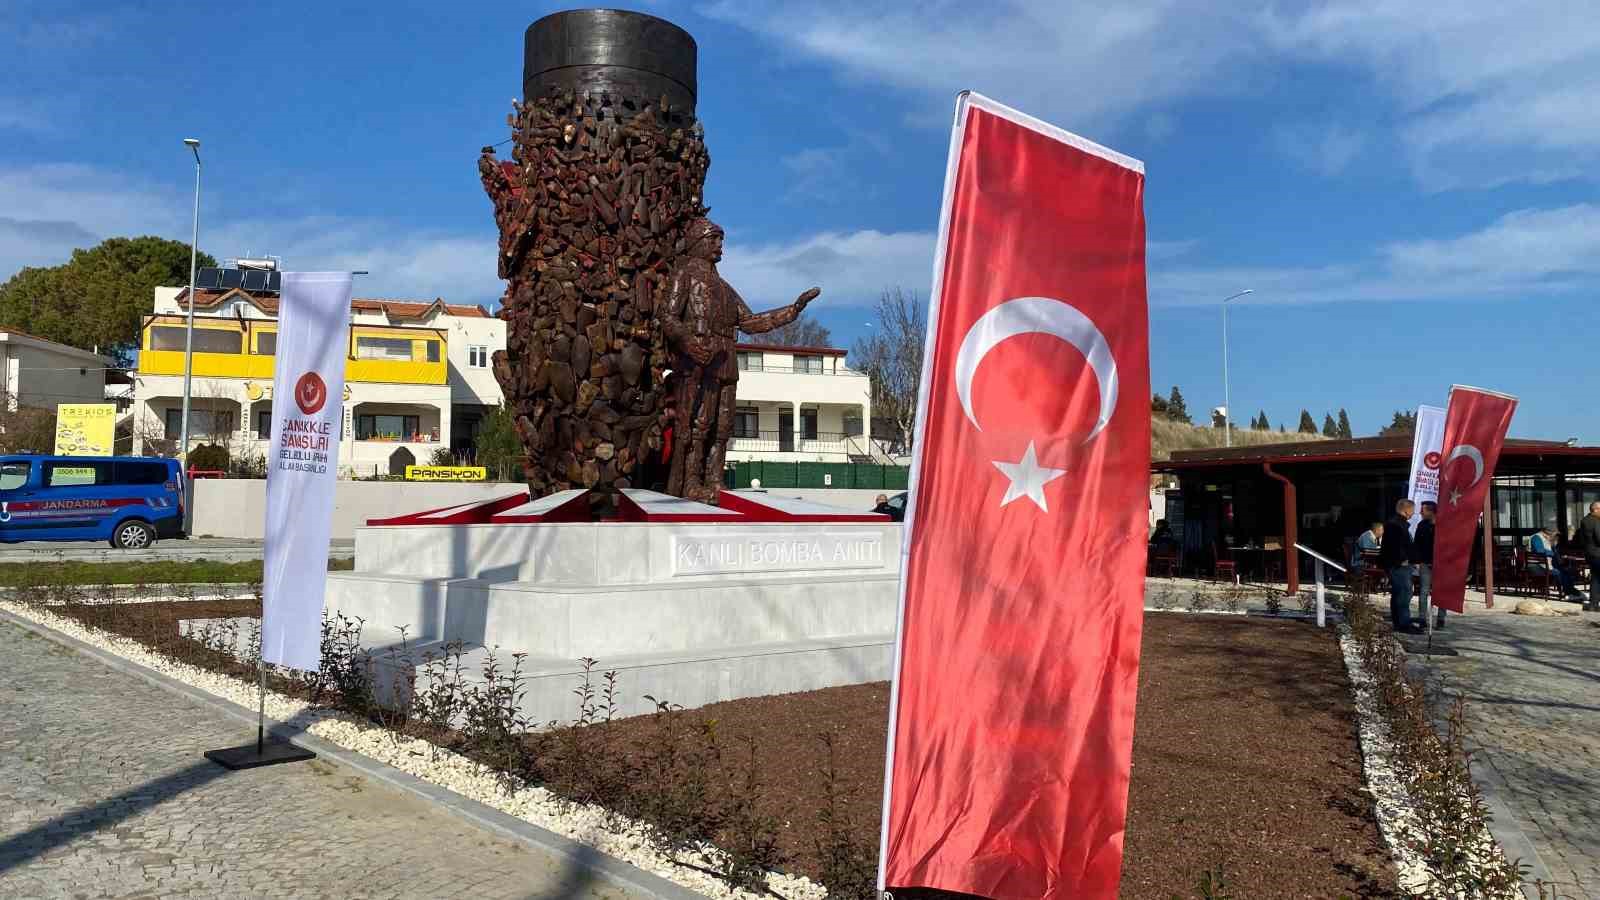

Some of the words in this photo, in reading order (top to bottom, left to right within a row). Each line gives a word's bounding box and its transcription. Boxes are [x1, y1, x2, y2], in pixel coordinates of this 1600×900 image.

[411, 467, 481, 478] PANSİYON
[43, 498, 107, 510] JANDARMA
[679, 542, 742, 567] KANLI
[751, 540, 824, 564] BOMBA
[832, 538, 881, 562] ANITI
